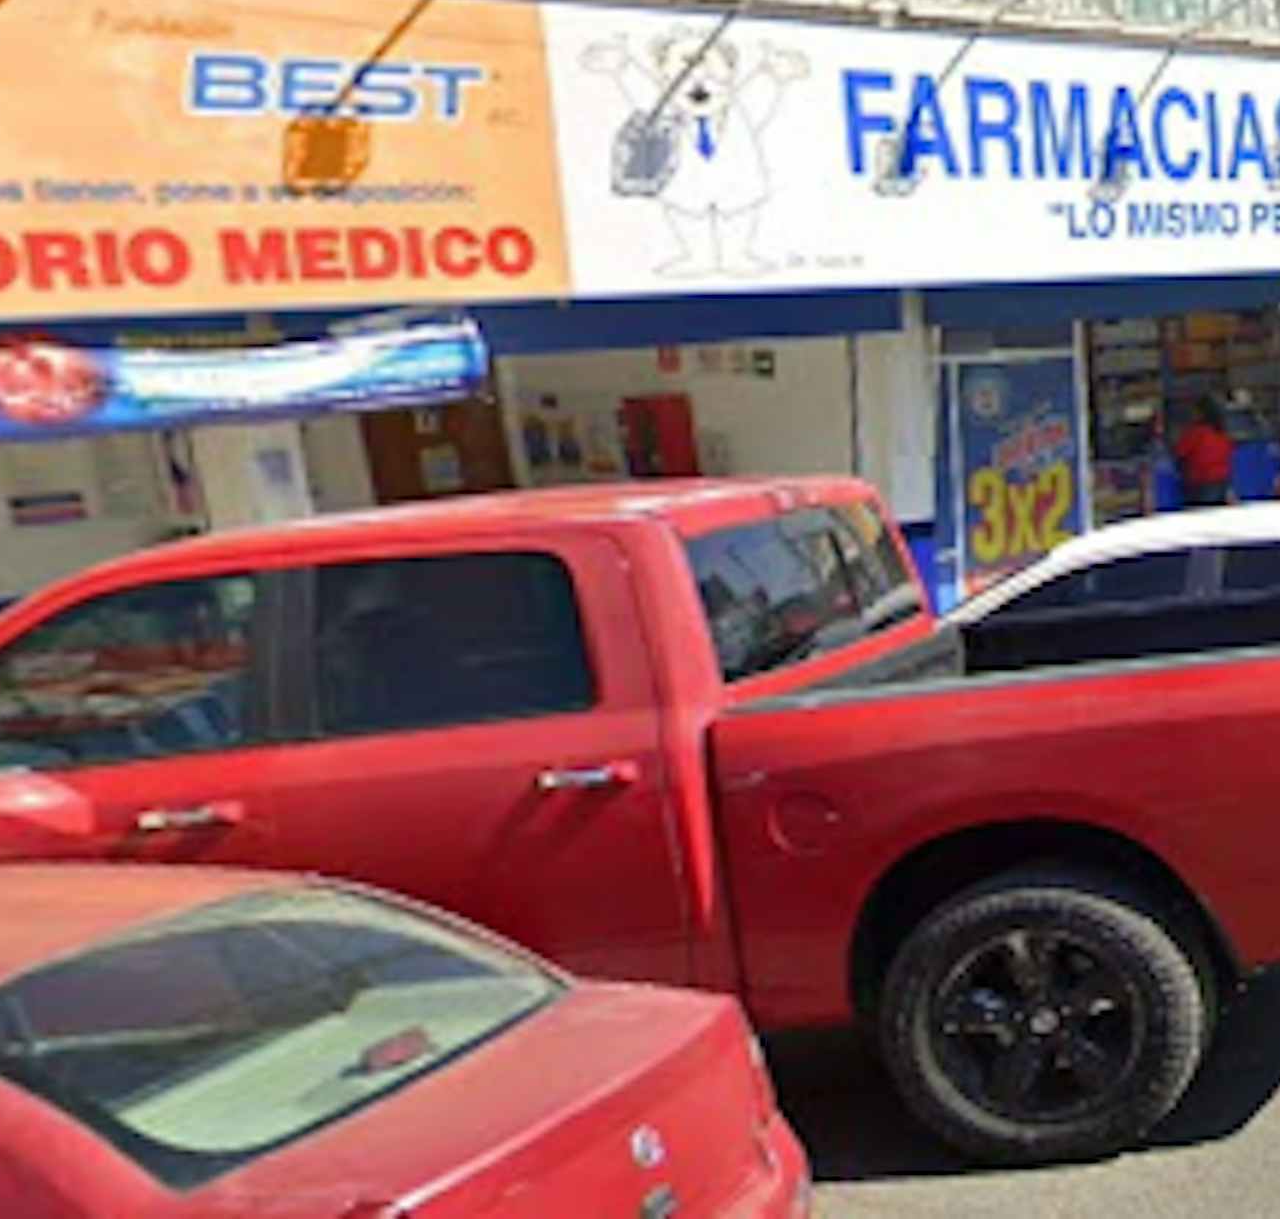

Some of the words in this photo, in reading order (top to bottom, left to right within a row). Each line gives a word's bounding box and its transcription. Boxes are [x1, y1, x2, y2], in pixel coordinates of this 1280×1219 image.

[192, 54, 483, 118] BEST
[1127, 202, 1240, 238] MISMO
[219, 225, 537, 285] MEDICO
